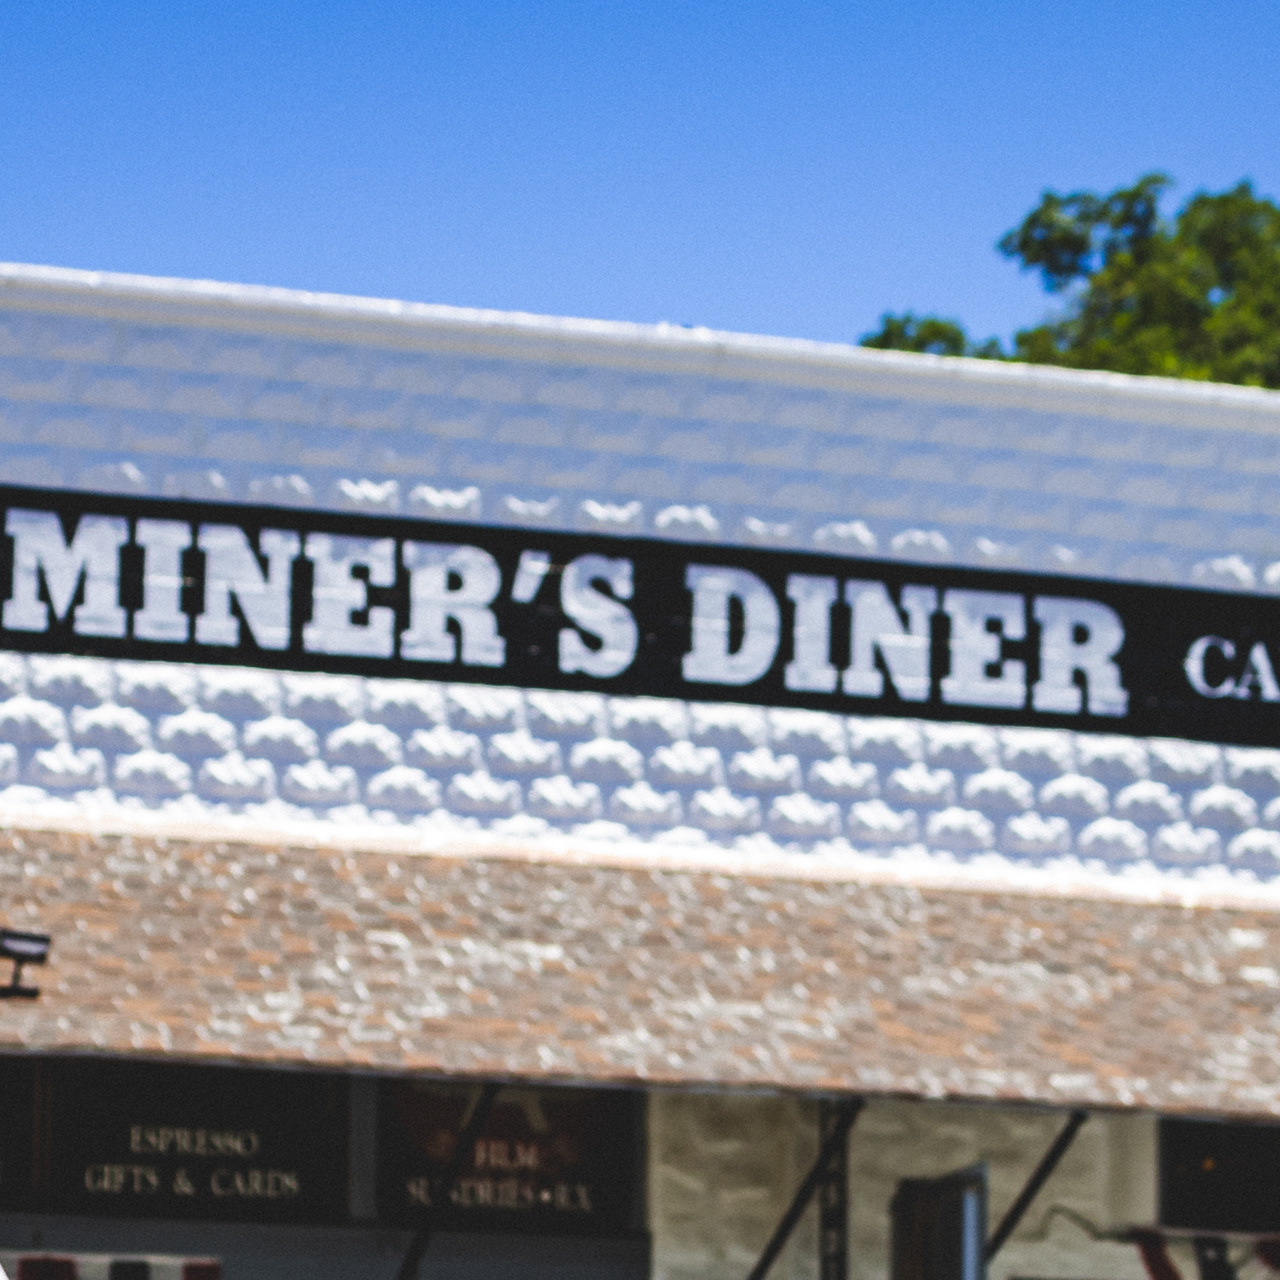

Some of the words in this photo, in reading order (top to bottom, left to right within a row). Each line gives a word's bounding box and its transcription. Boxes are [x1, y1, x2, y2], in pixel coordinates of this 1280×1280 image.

[1, 507, 639, 678] MINER'S
[682, 562, 1129, 717] DINER
[128, 1124, 261, 1158] ESPRESSO
[83, 1162, 161, 1195] GIFTS
[172, 1168, 196, 1197] &
[209, 1168, 301, 1199] CARDS
